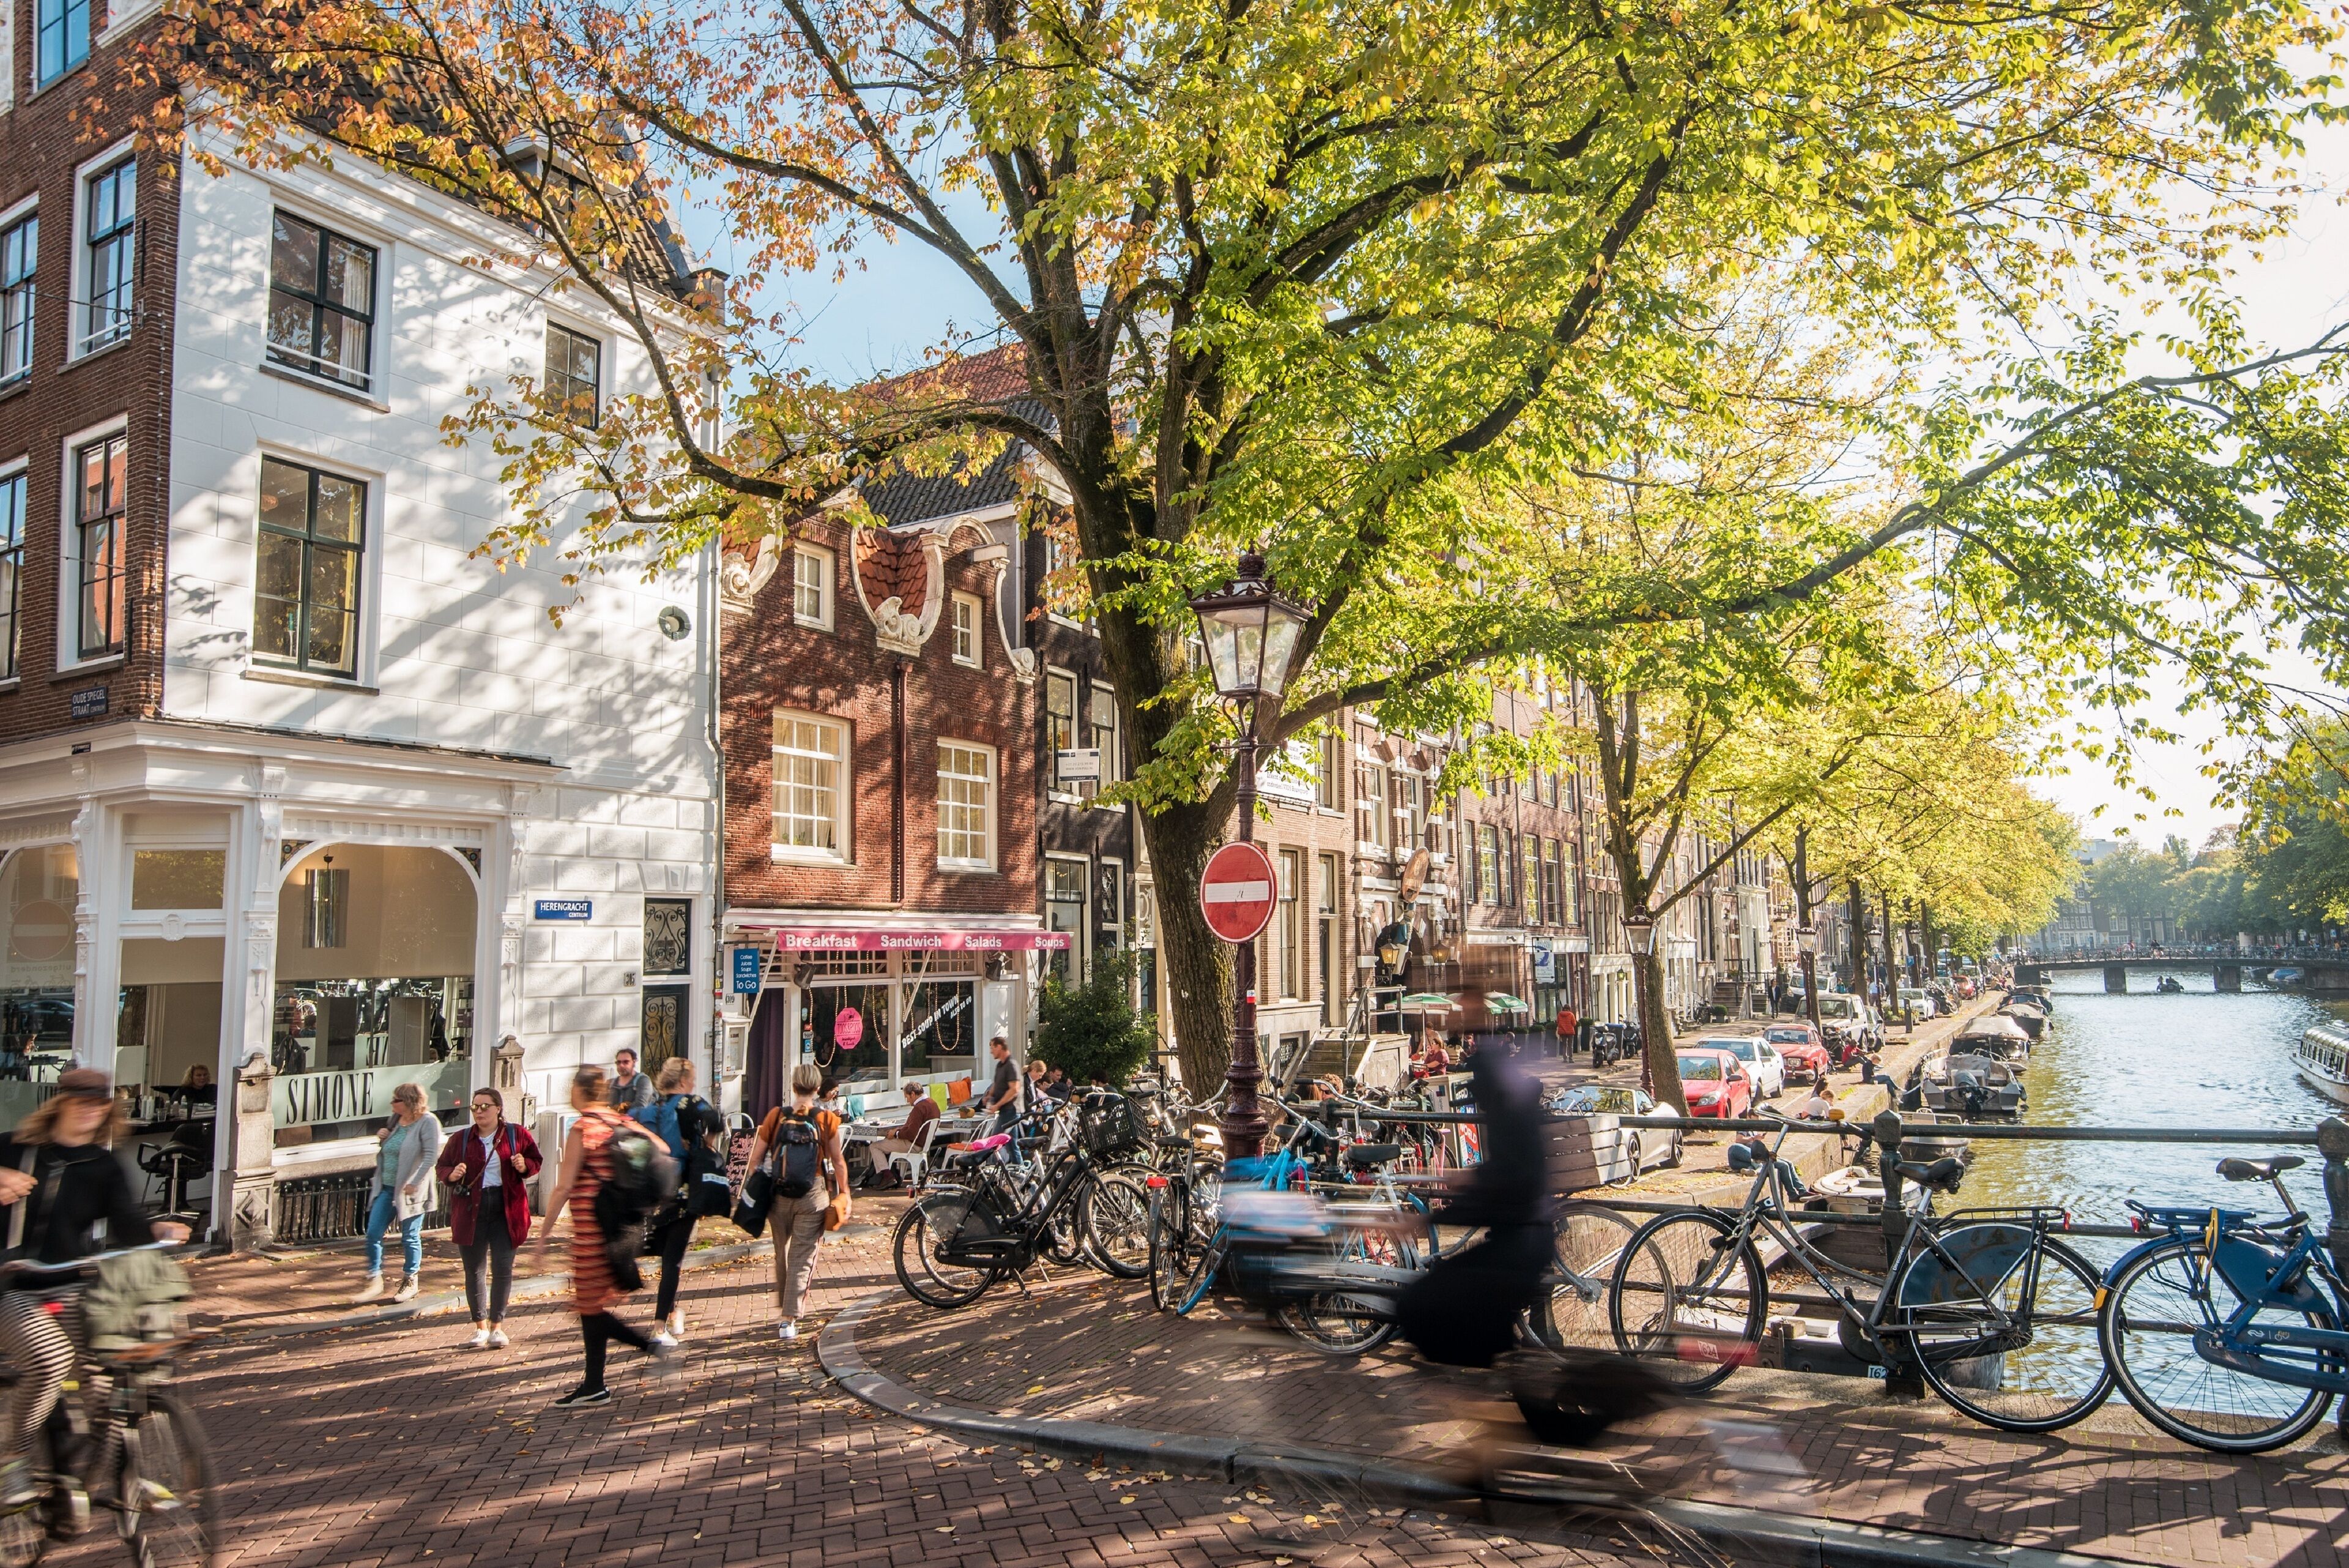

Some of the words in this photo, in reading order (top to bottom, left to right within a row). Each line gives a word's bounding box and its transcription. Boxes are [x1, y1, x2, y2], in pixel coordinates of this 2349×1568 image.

[73, 692, 86, 704] OUDE
[87, 689, 105, 702] SPIEGEL
[73, 704, 90, 716] STRAAT
[540, 902, 588, 911] HERENGRACHT
[785, 934, 857, 948] Breakfast
[881, 935, 941, 947] Sandwich
[965, 936, 1002, 948] Salads
[1035, 937, 1065, 949] Soups
[736, 980, 744, 989] To
[745, 980, 757, 989] Go
[966, 995, 972, 1005] GO
[902, 1029, 916, 1049] BEST
[918, 1016, 933, 1036] SOUP
[941, 994, 959, 1015] TOWN
[286, 1072, 374, 1125] SIMONE
